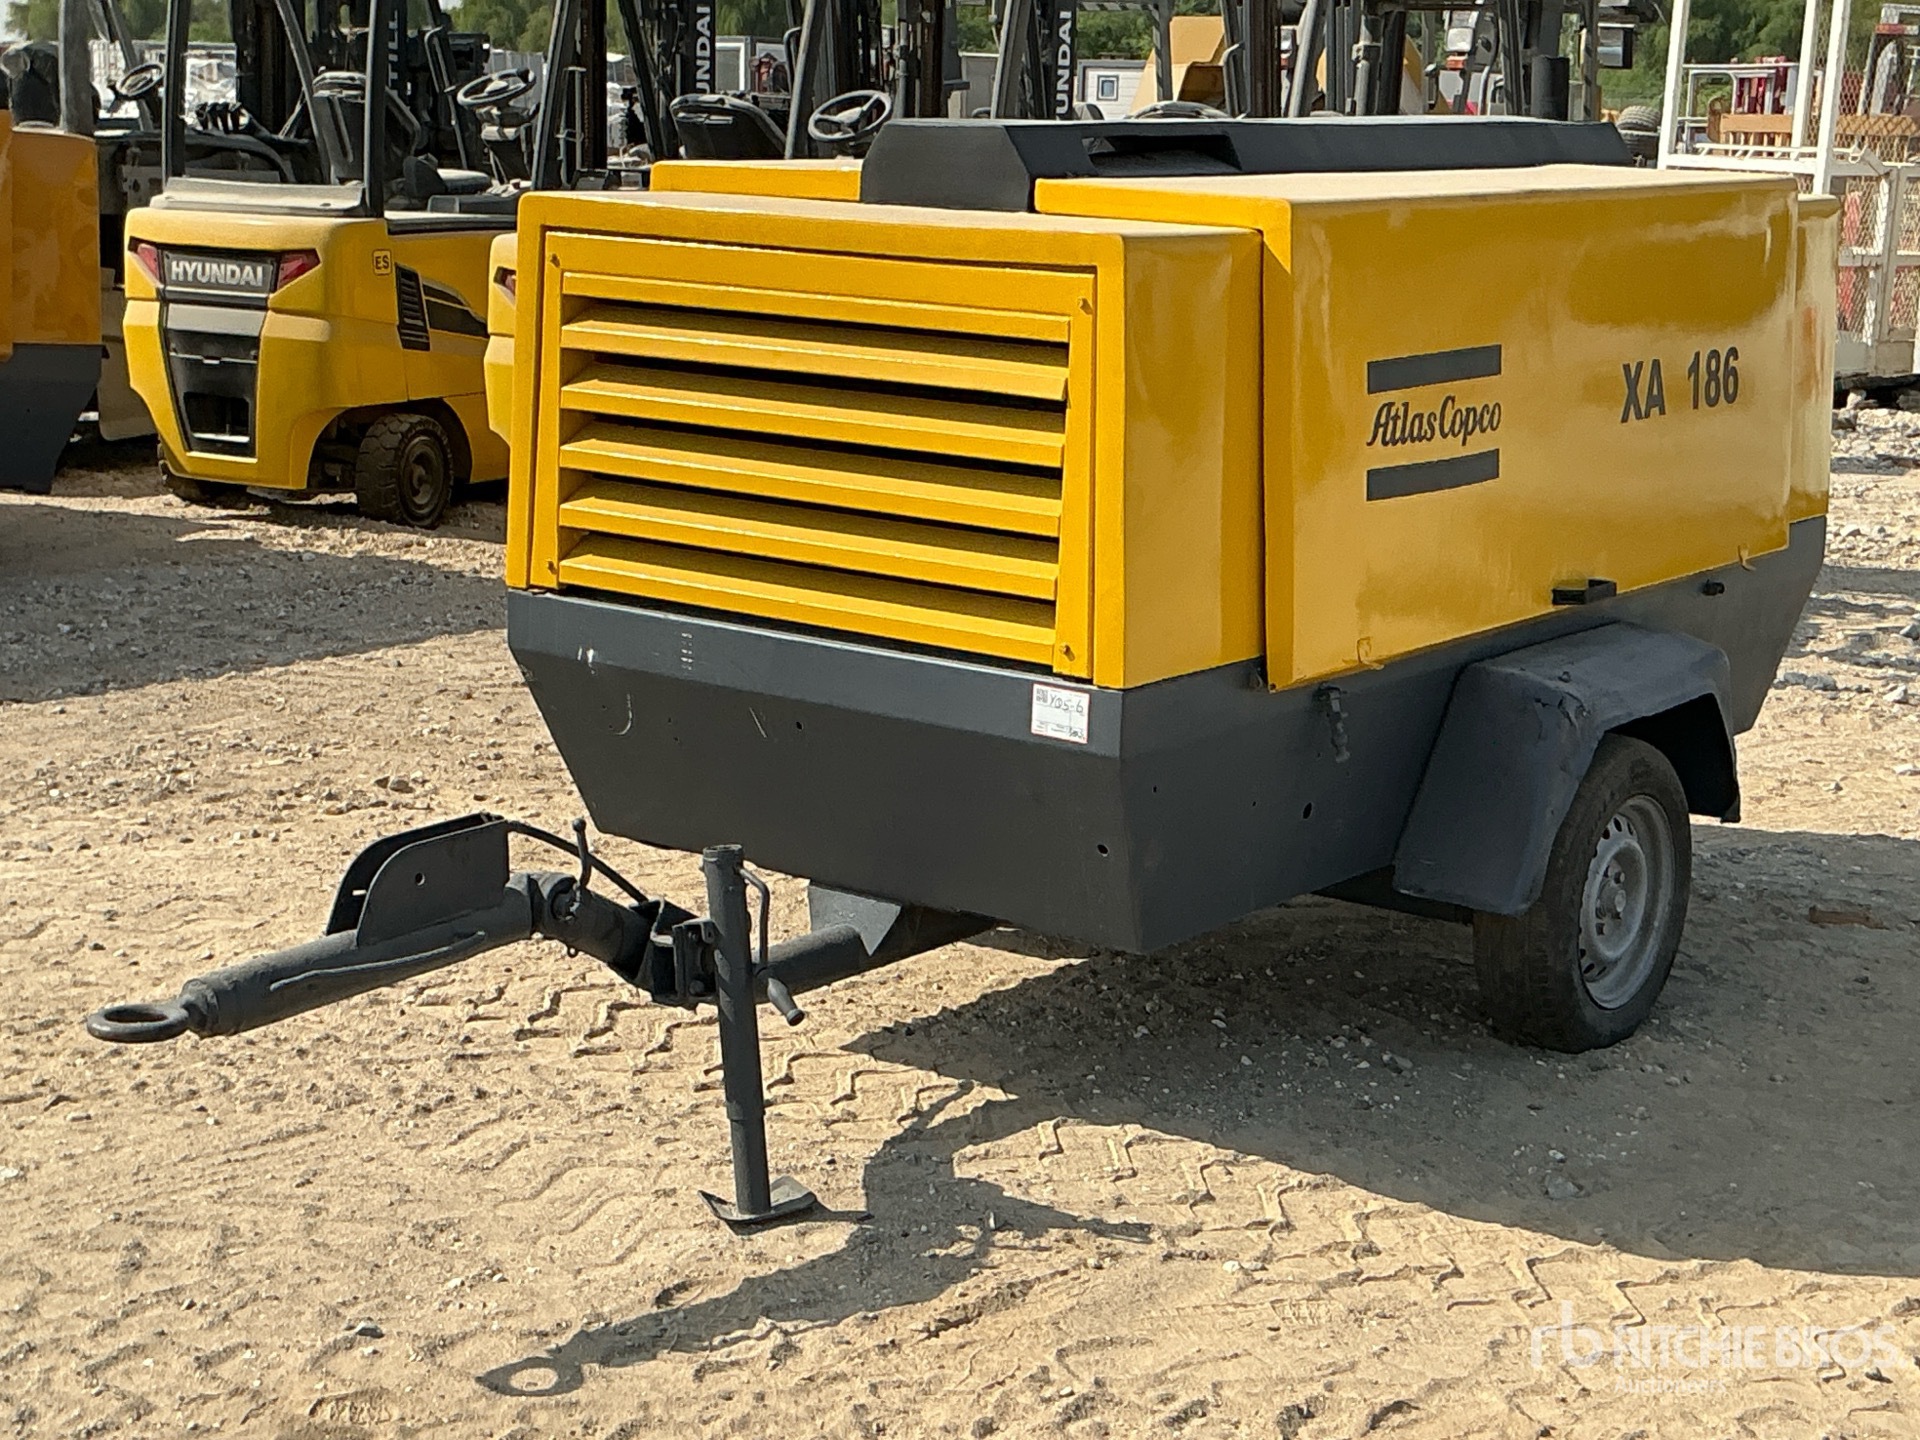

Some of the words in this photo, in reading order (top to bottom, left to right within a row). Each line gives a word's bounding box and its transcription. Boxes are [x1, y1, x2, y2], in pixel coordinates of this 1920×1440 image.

[1055, 10, 1072, 120] UNDAI
[170, 259, 264, 287] HYUNDAI
[375, 254, 390, 271] ES
[1620, 358, 1667, 424] XA
[1687, 346, 1740, 411] 186
